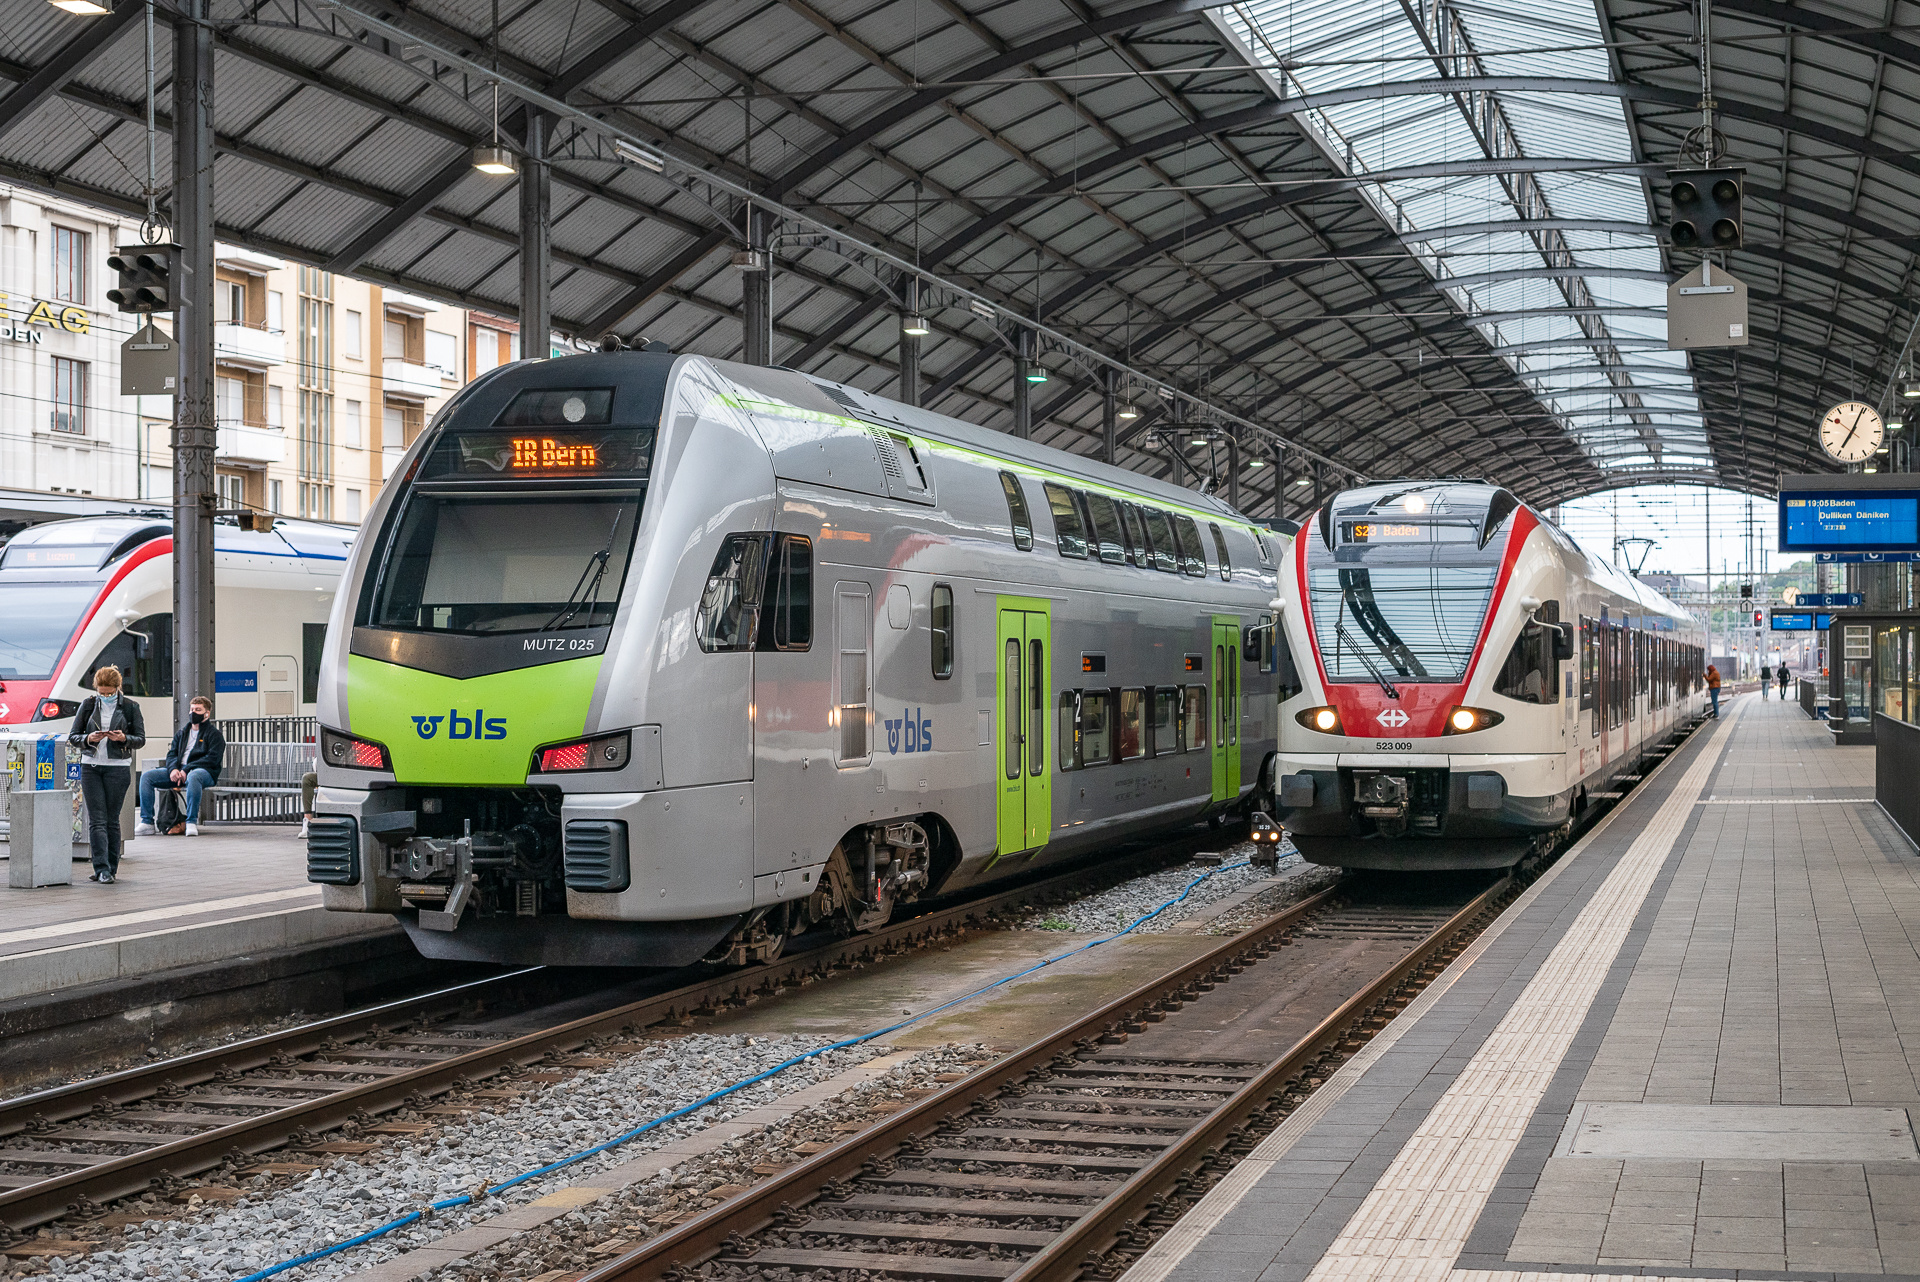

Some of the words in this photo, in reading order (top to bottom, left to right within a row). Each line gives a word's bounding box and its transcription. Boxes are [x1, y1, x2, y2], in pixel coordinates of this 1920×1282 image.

[25, 301, 90, 334] AG
[0, 325, 43, 343] DEN
[513, 439, 538, 467] IR
[542, 439, 595, 467] Bern
[1807, 500, 1829, 508] 19:05
[1856, 511, 1890, 519] Däniken
[1355, 525, 1377, 536] S23
[1383, 525, 1420, 536] Baden
[46, 552, 76, 561] Luzern
[523, 639, 566, 650] MUTZ
[569, 639, 595, 650] 025
[244, 679, 255, 687] ZUG
[1075, 693, 1081, 723] 2
[1179, 688, 1184, 714] 2
[448, 709, 508, 740] bls
[904, 707, 932, 753] bls
[1376, 742, 1394, 750] 523
[1394, 742, 1412, 750] 009
